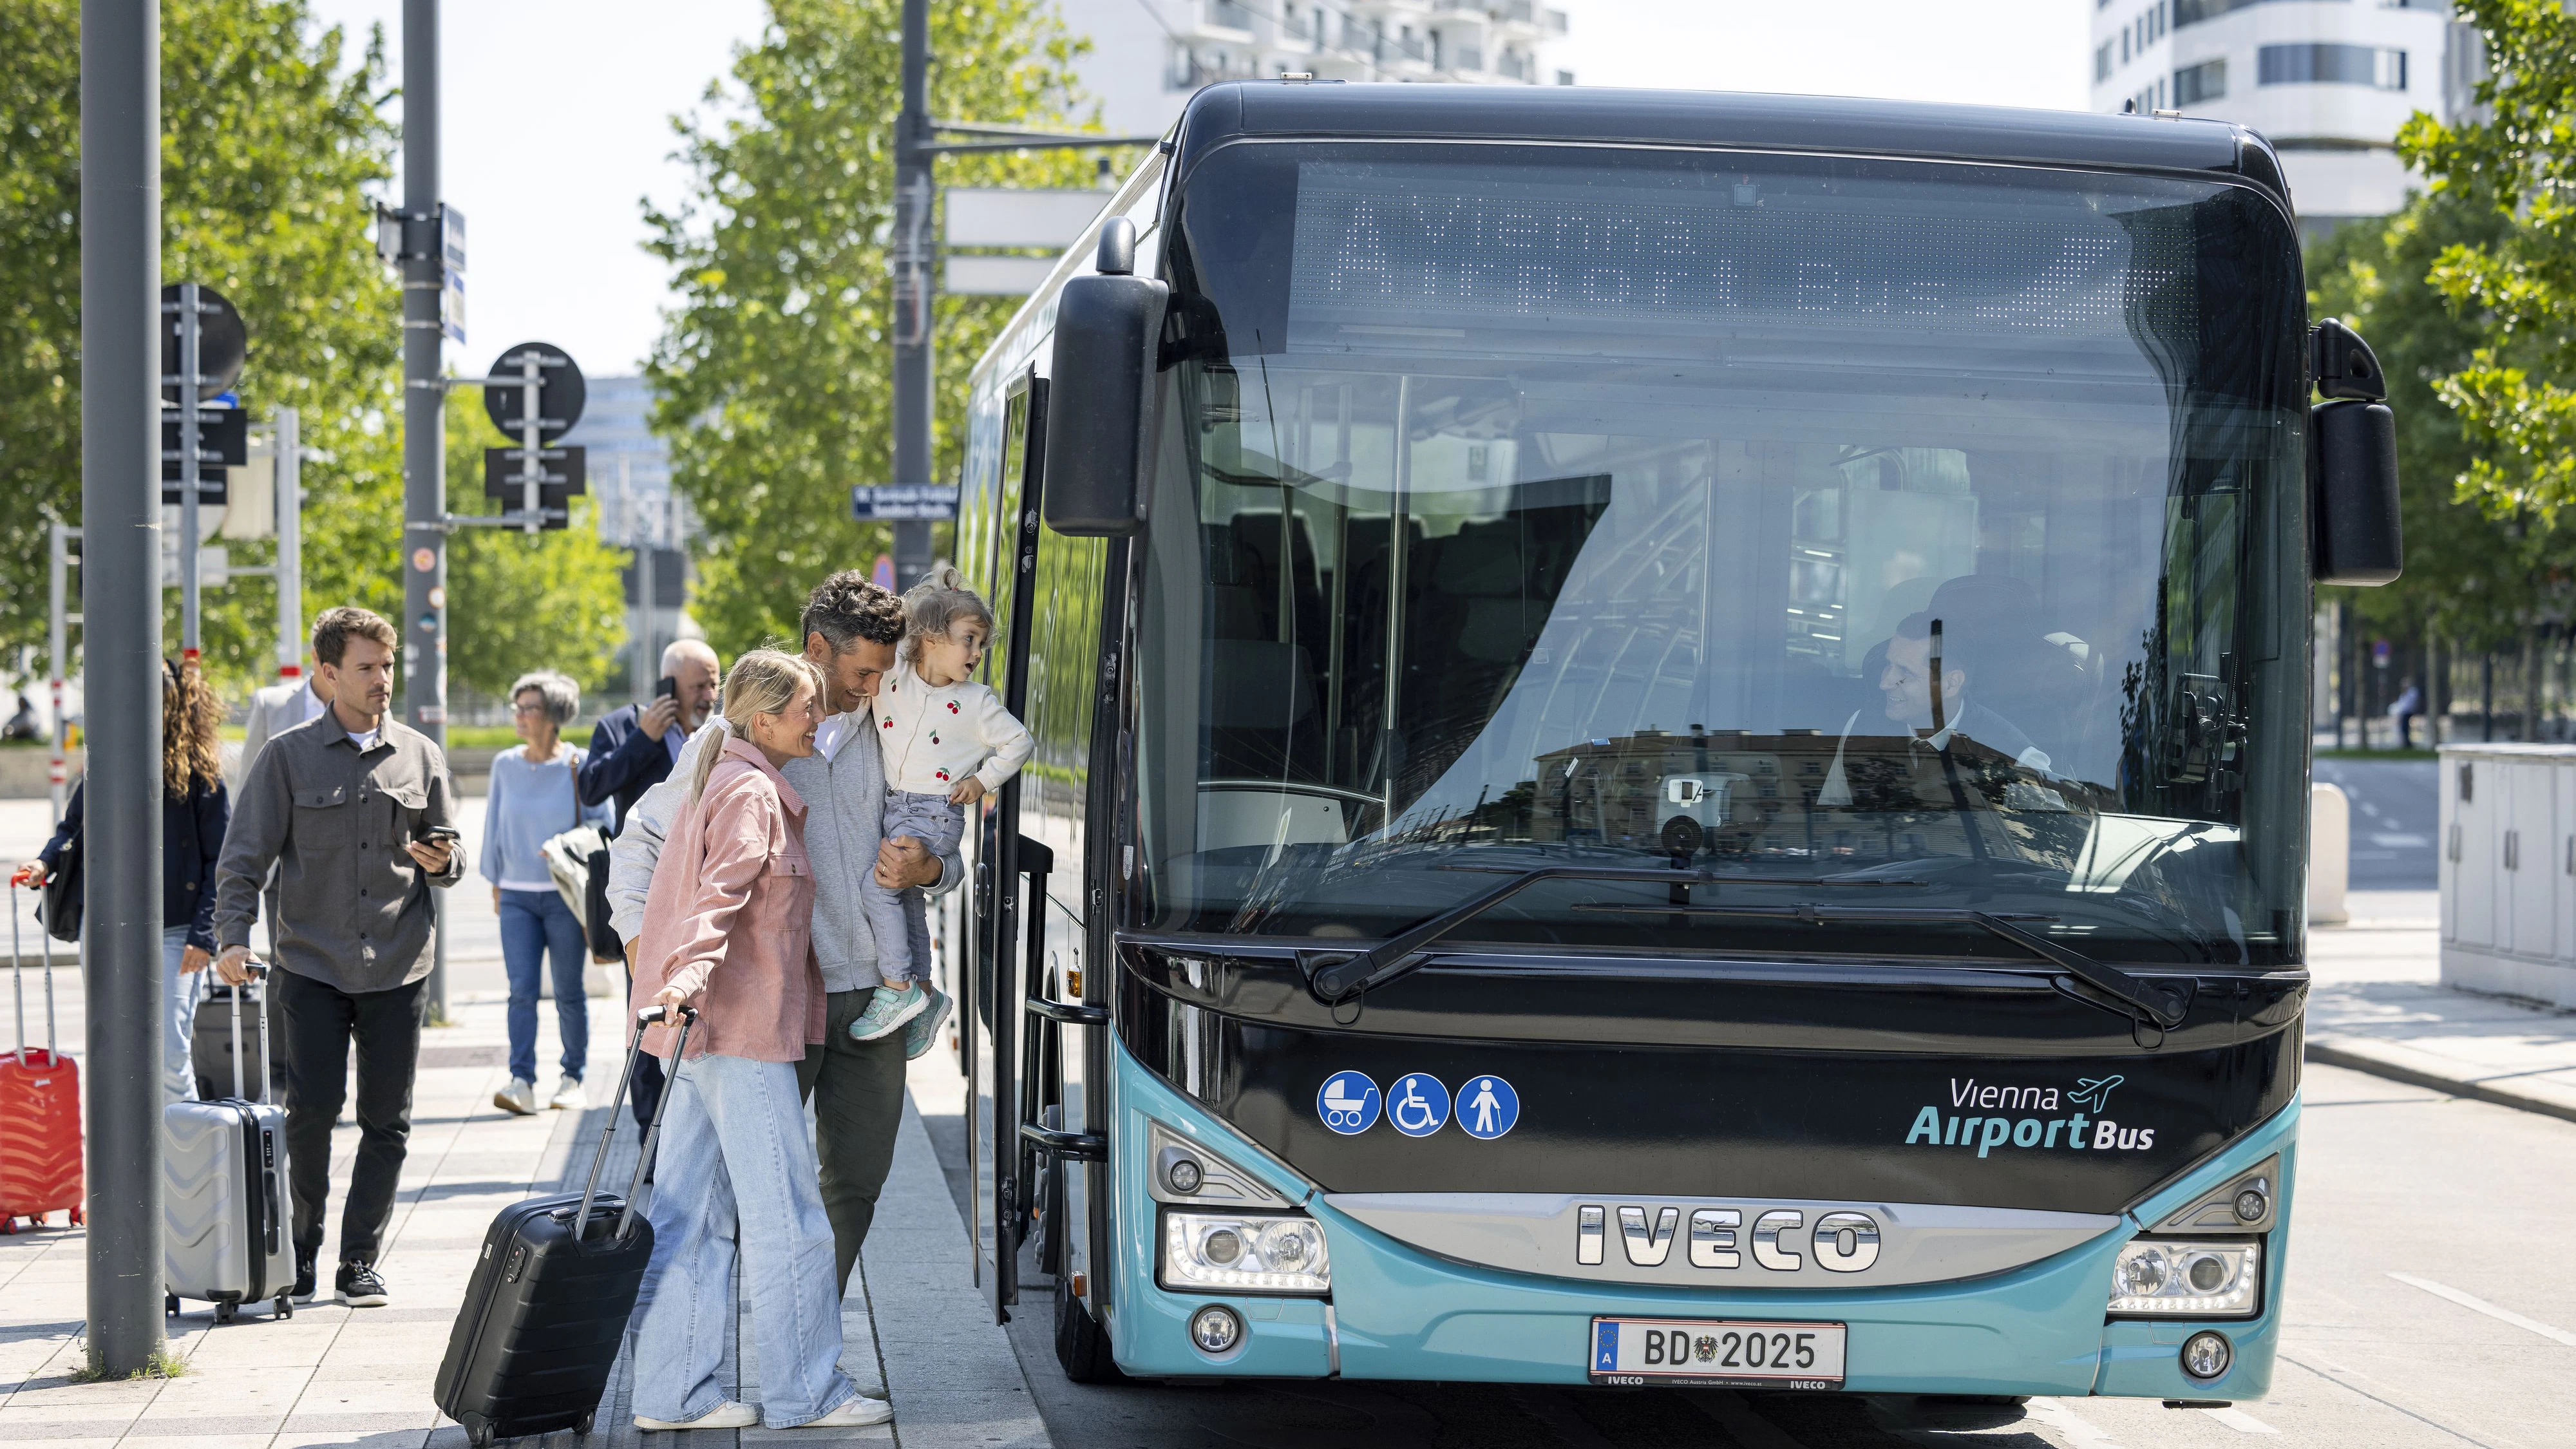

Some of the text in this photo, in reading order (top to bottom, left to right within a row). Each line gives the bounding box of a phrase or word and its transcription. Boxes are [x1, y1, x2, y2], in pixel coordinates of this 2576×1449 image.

[1797, 261, 1946, 316] Bus
[1951, 1077, 2058, 1110] Vienna
[1904, 1106, 2155, 1158] Airport Bus
[1576, 1204, 1881, 1273] IVECO
[1602, 1352, 1612, 1365] A
[1645, 1329, 1816, 1368] BD 2025
[1607, 1376, 1643, 1385] IVECO
[1790, 1380, 1826, 1390] IVECO
